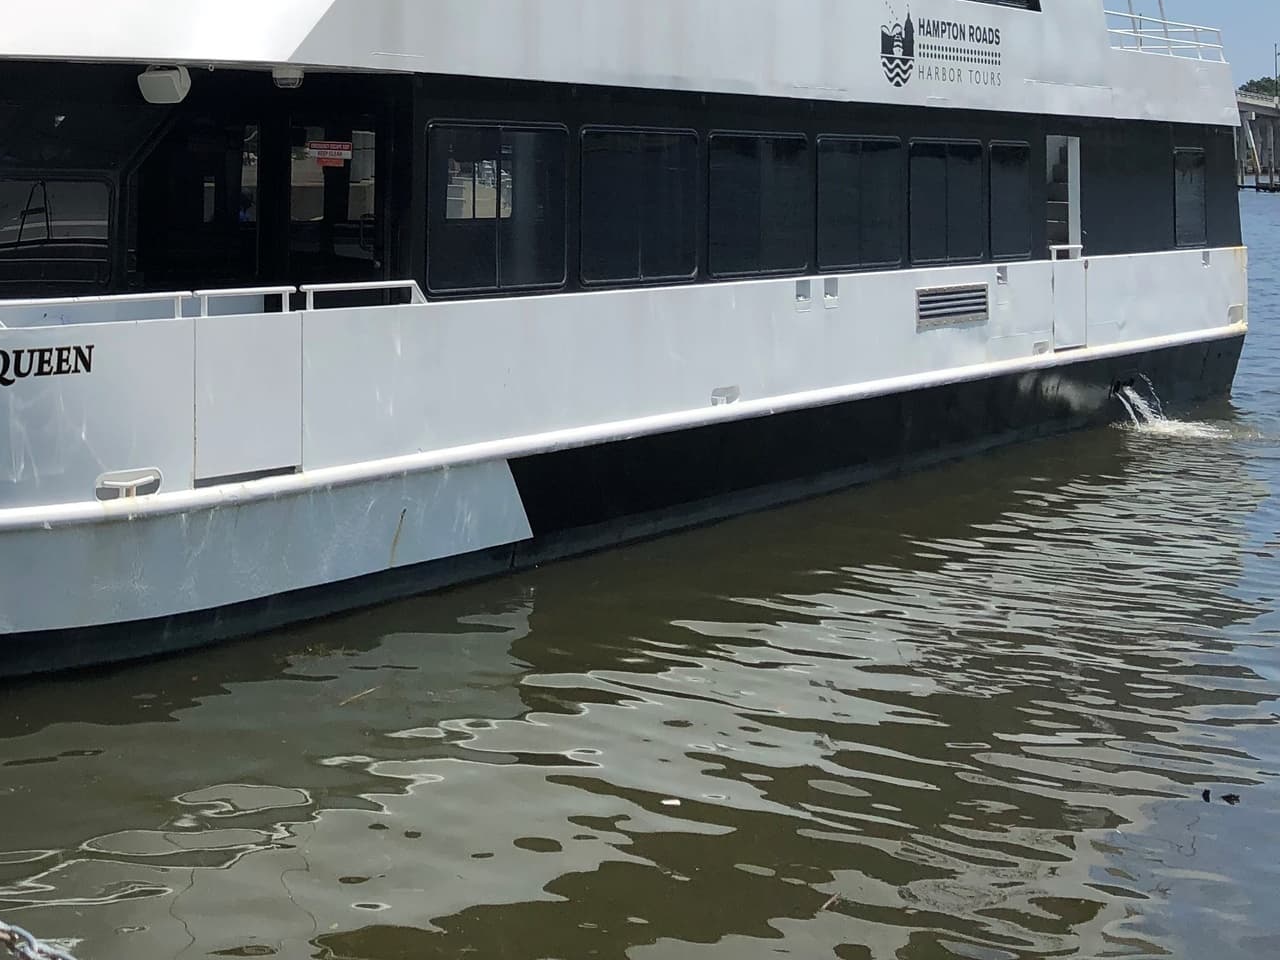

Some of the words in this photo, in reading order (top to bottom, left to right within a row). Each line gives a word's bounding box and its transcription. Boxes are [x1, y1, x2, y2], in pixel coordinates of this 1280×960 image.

[918, 17, 966, 41] HAMPTON
[968, 24, 1001, 46] ROADS
[918, 65, 963, 83] HARBOR
[967, 69, 1001, 87] TOURS
